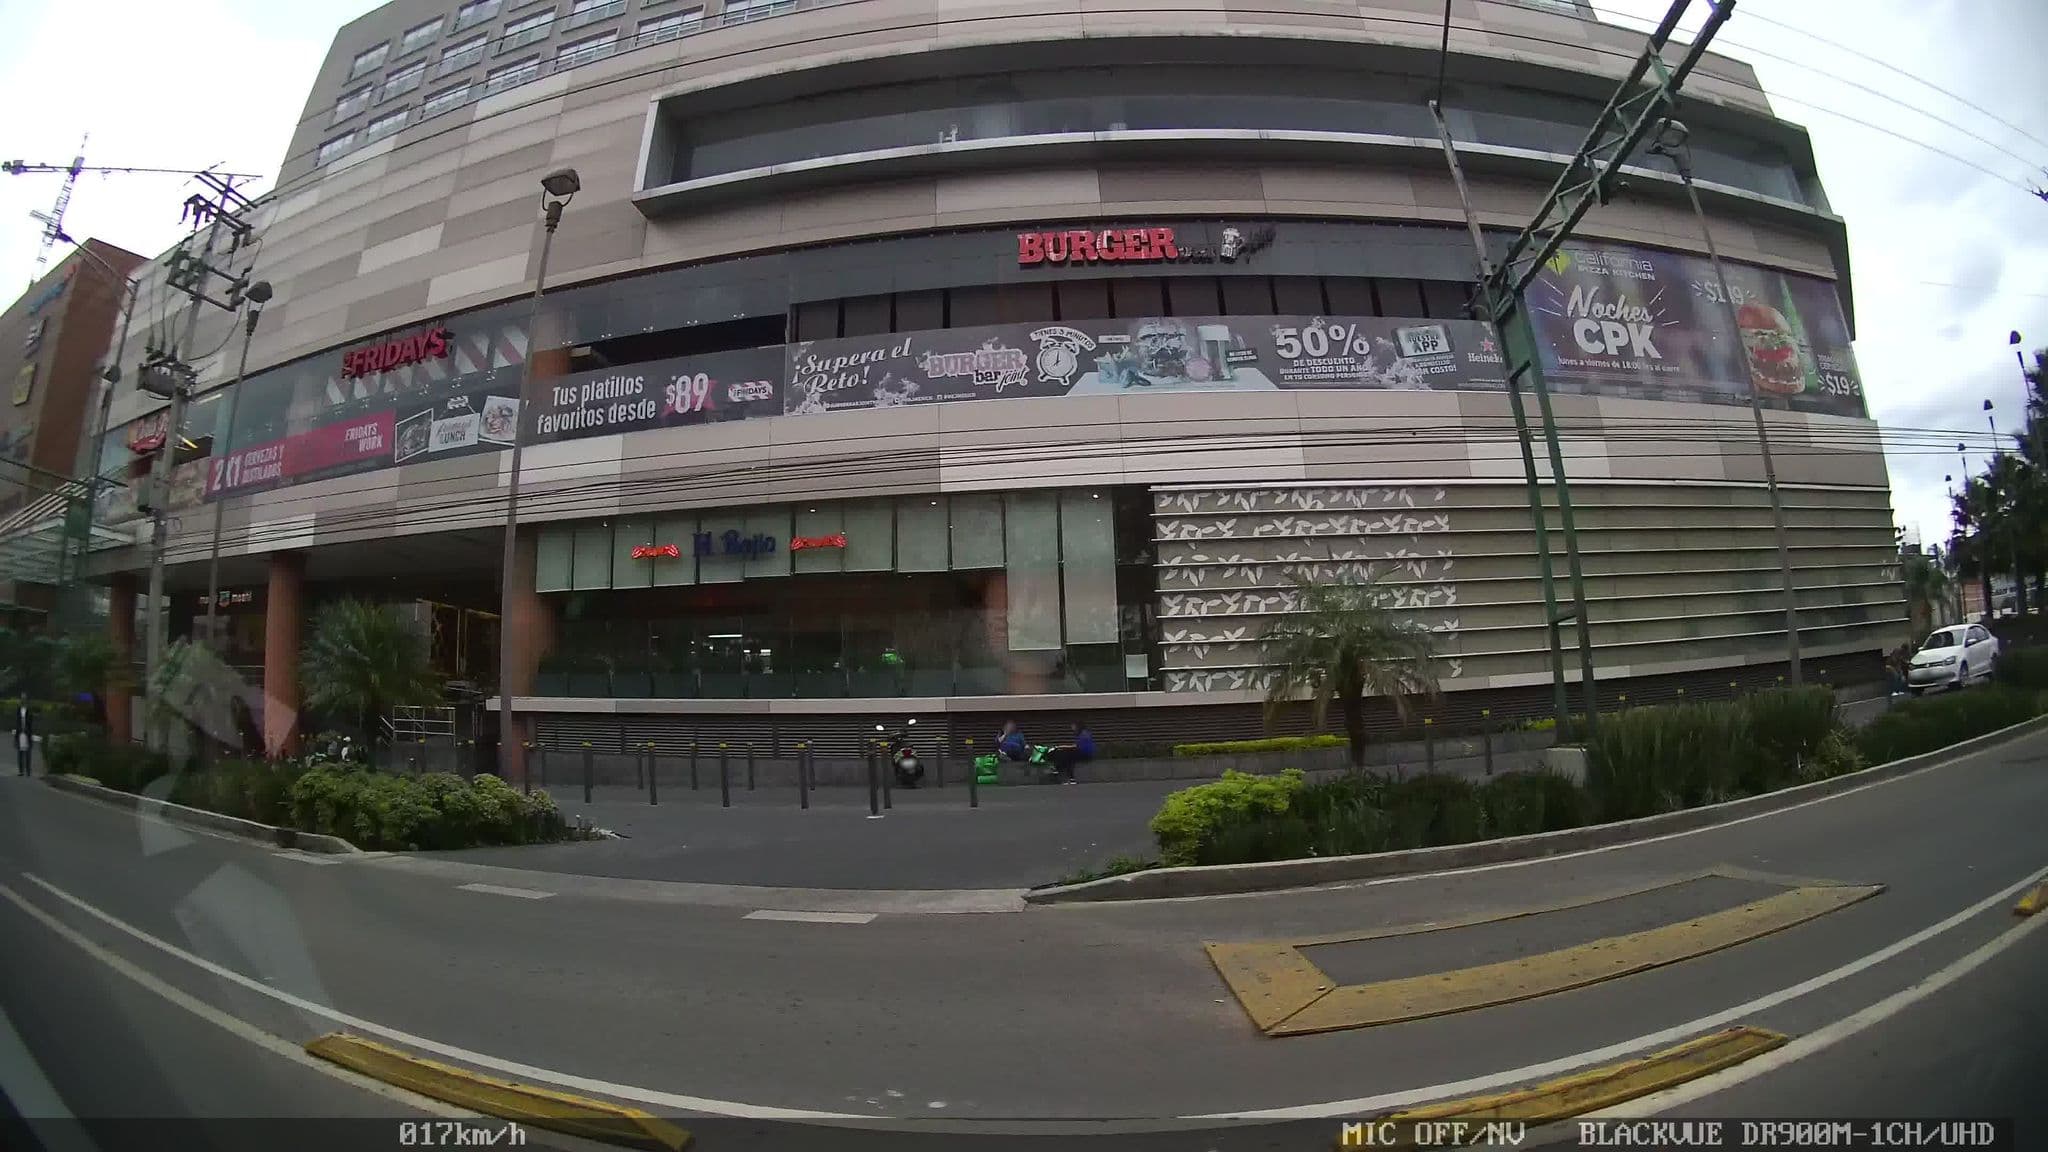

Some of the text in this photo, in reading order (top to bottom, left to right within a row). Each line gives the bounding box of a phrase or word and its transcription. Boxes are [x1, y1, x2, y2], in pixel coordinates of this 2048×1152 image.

[1018, 227, 1178, 264] BURGER
[1567, 284, 1653, 323] Noches
[350, 327, 448, 377] FRIDAYS
[891, 337, 913, 359] el
[1275, 324, 1370, 359] 50%
[1412, 340, 1439, 353] APP
[1573, 318, 1662, 359] CPK
[928, 351, 1024, 375] BURGER
[1293, 357, 1355, 367] DE DESCUENTO
[1430, 364, 1457, 374] COSTO!
[803, 365, 871, 396] Reto!
[975, 369, 1000, 383] bar
[1825, 372, 1850, 396] $19
[553, 375, 644, 408] Tus platillos
[666, 372, 709, 414] $89
[536, 399, 656, 434] favoritos desde
[344, 422, 378, 442] FRIDAYS
[358, 433, 384, 453] WORK
